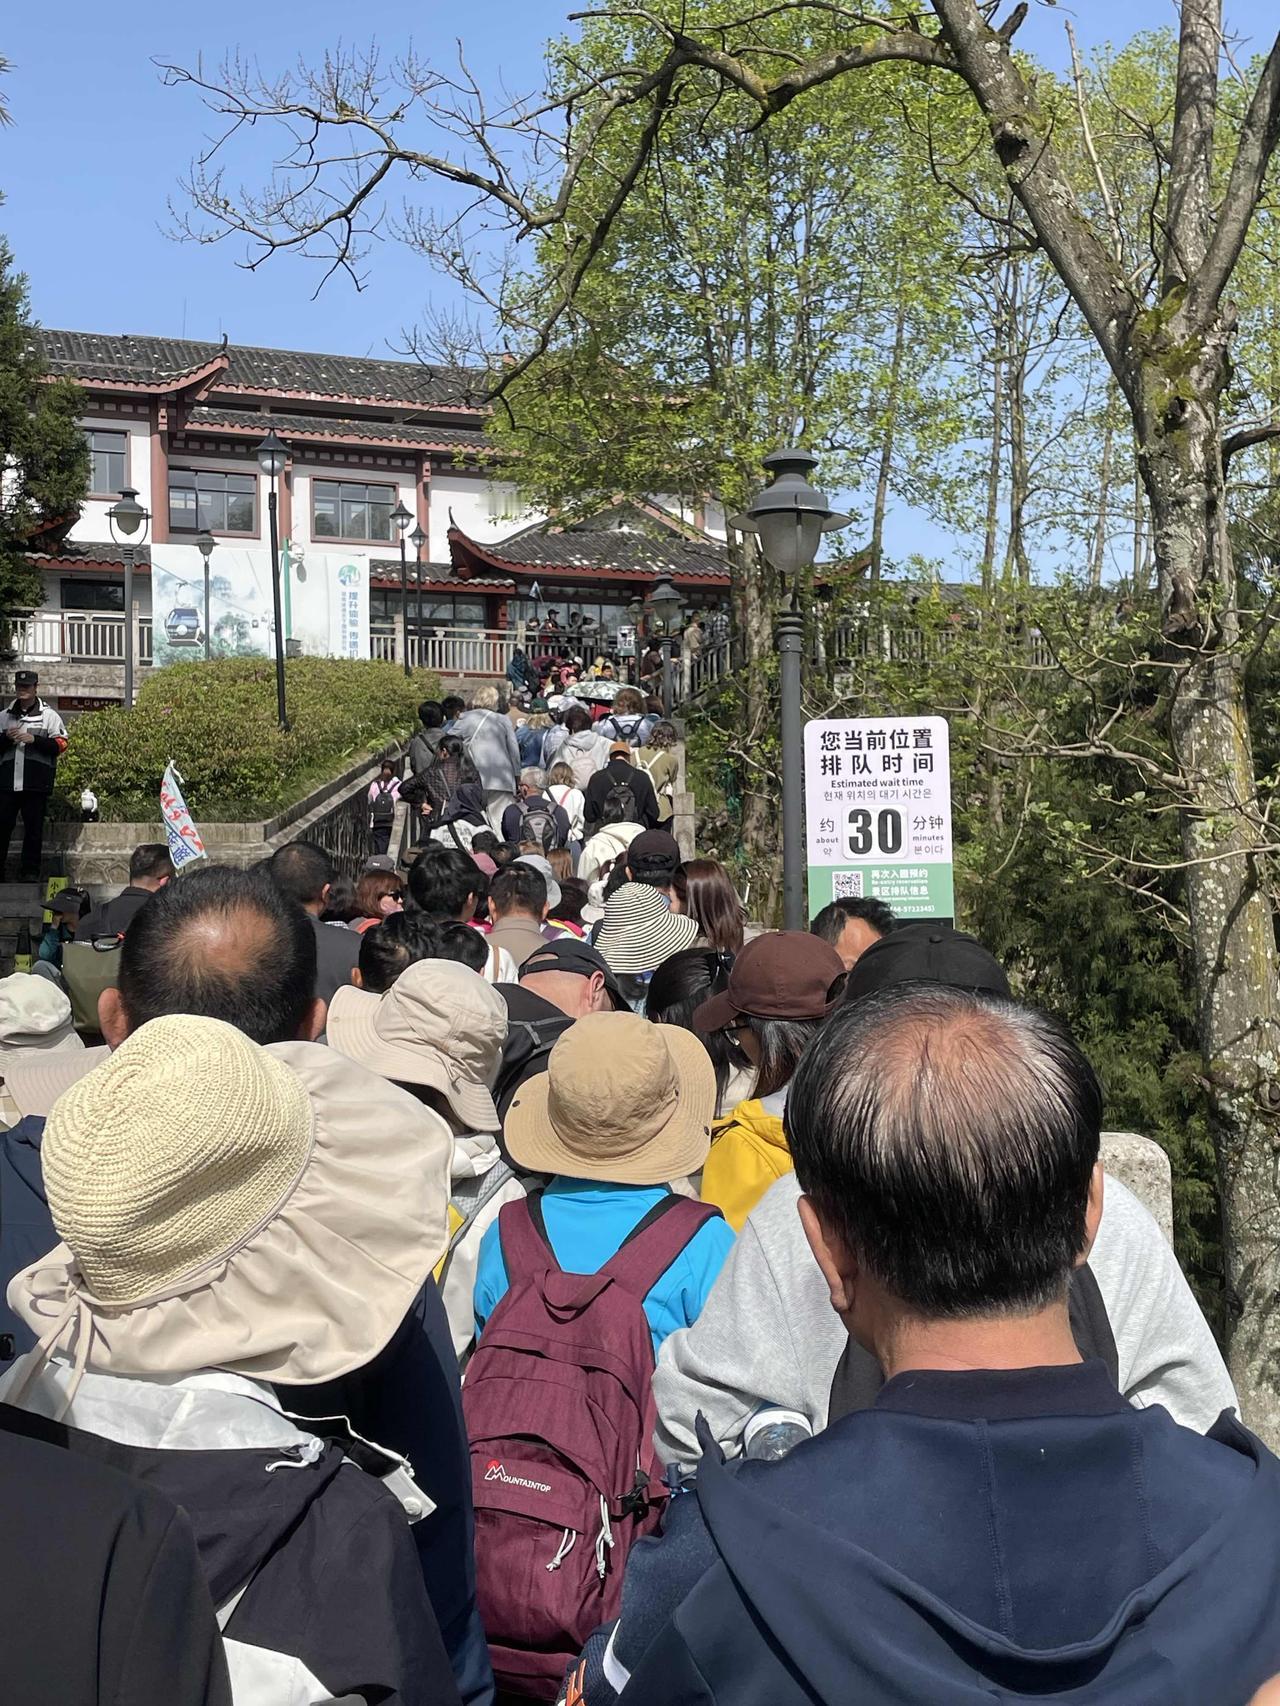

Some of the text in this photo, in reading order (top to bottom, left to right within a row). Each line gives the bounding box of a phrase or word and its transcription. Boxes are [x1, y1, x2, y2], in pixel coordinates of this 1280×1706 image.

[820, 728, 933, 751] 您当前位置
[820, 753, 934, 776] 排队时间
[831, 778, 924, 789] Estimated wait time
[824, 788, 933, 802] 현재 위치의 대기 시간은
[819, 817, 835, 833] 约
[913, 815, 944, 831] 分钟
[848, 808, 902, 855] 30
[912, 834, 944, 842] minutes
[816, 836, 839, 844] about
